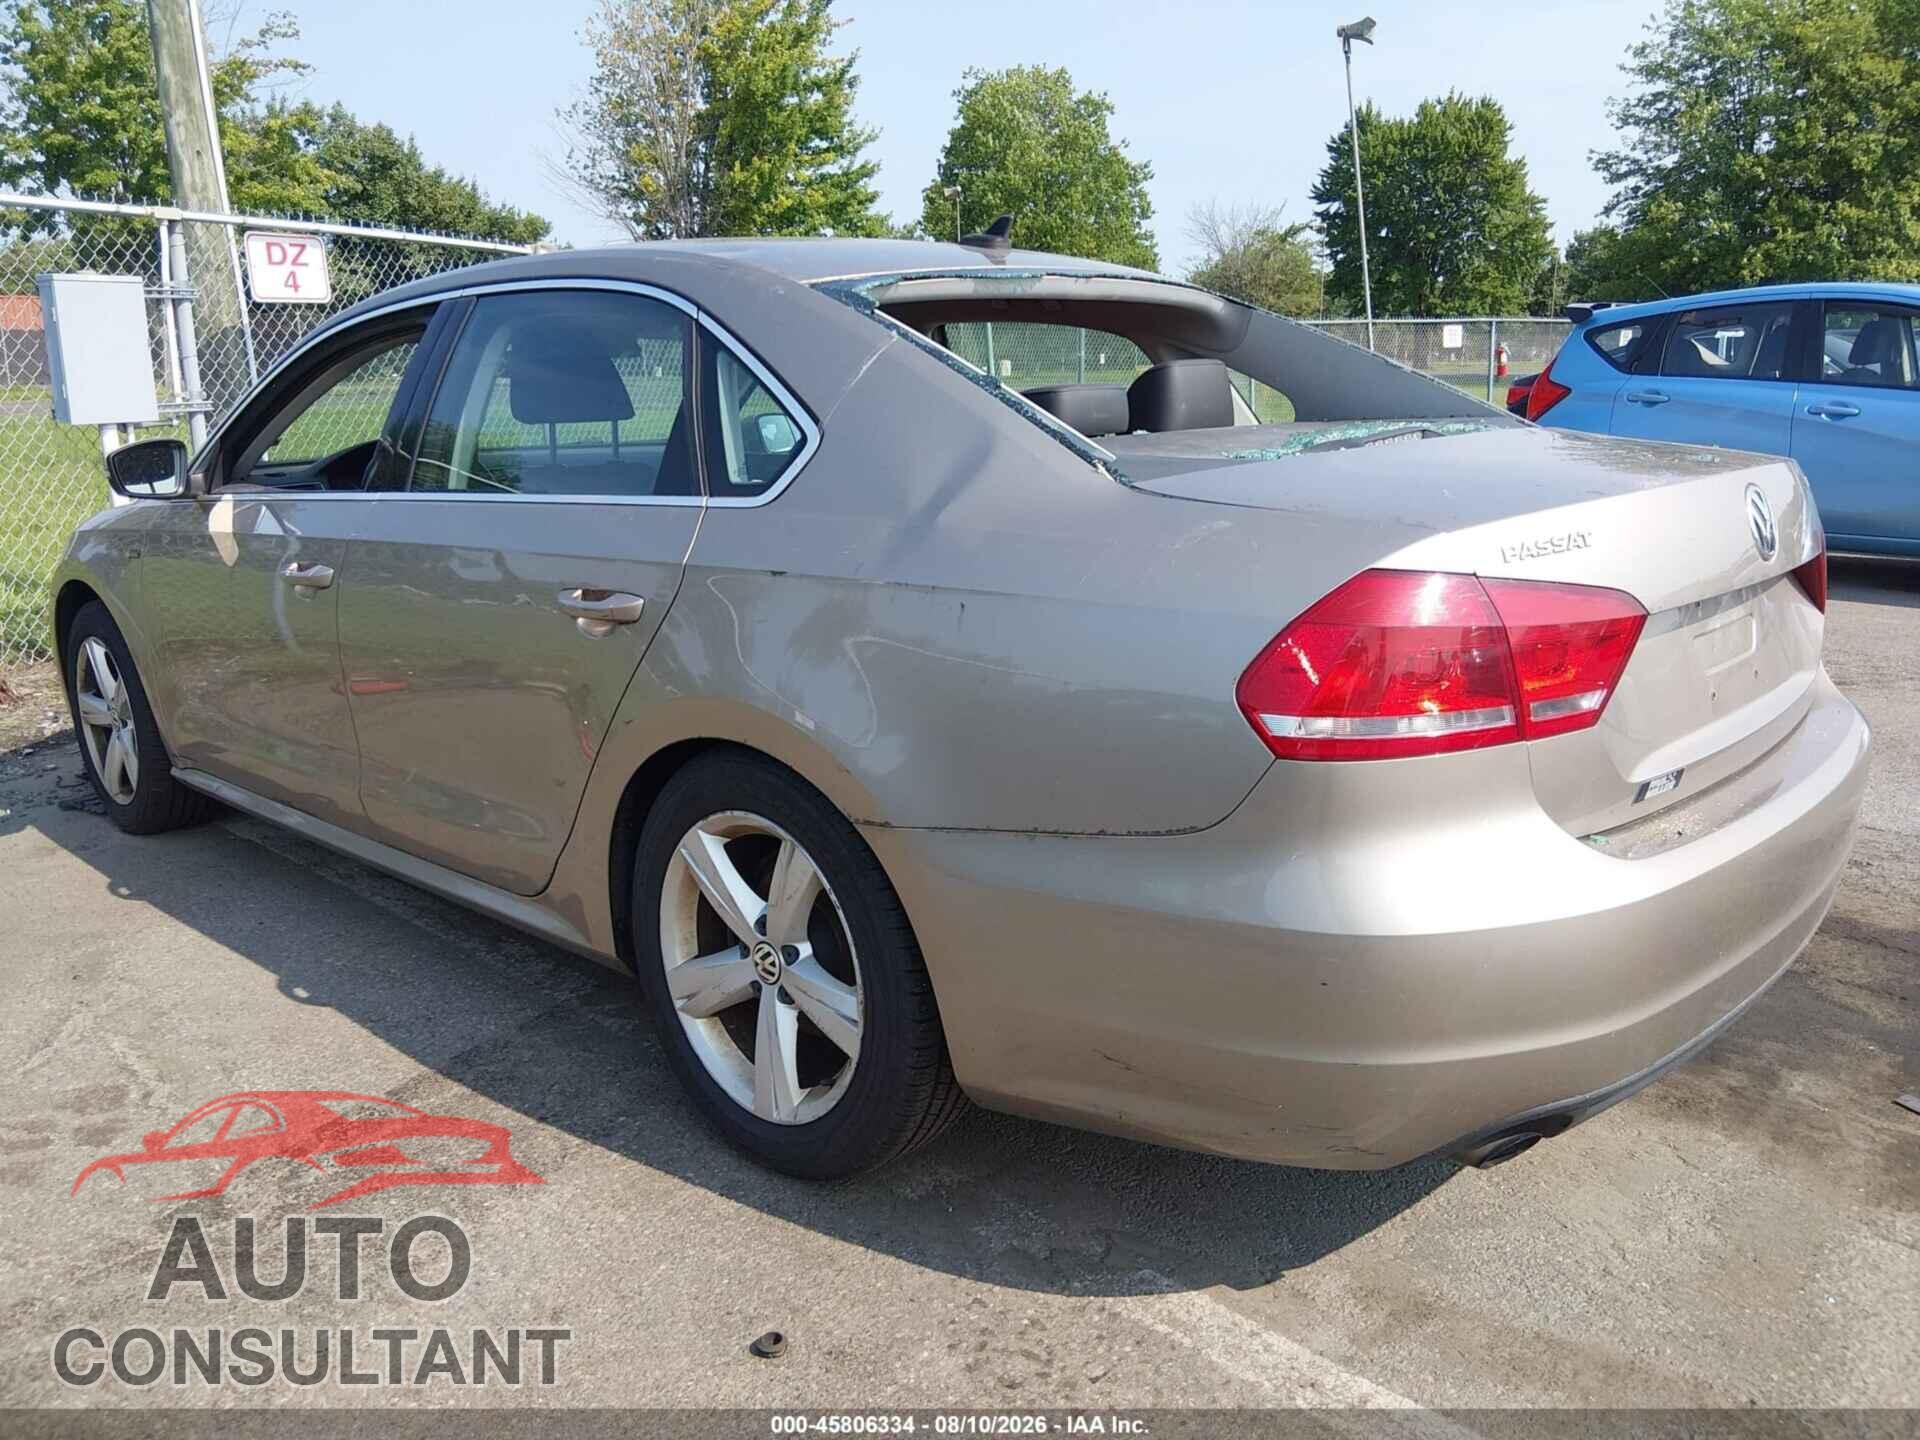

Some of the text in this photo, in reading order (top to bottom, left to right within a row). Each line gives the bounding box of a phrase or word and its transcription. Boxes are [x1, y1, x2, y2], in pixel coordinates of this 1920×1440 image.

[266, 242, 309, 266] DZ
[284, 271, 301, 293] 4
[1500, 531, 1592, 564] PASSAT
